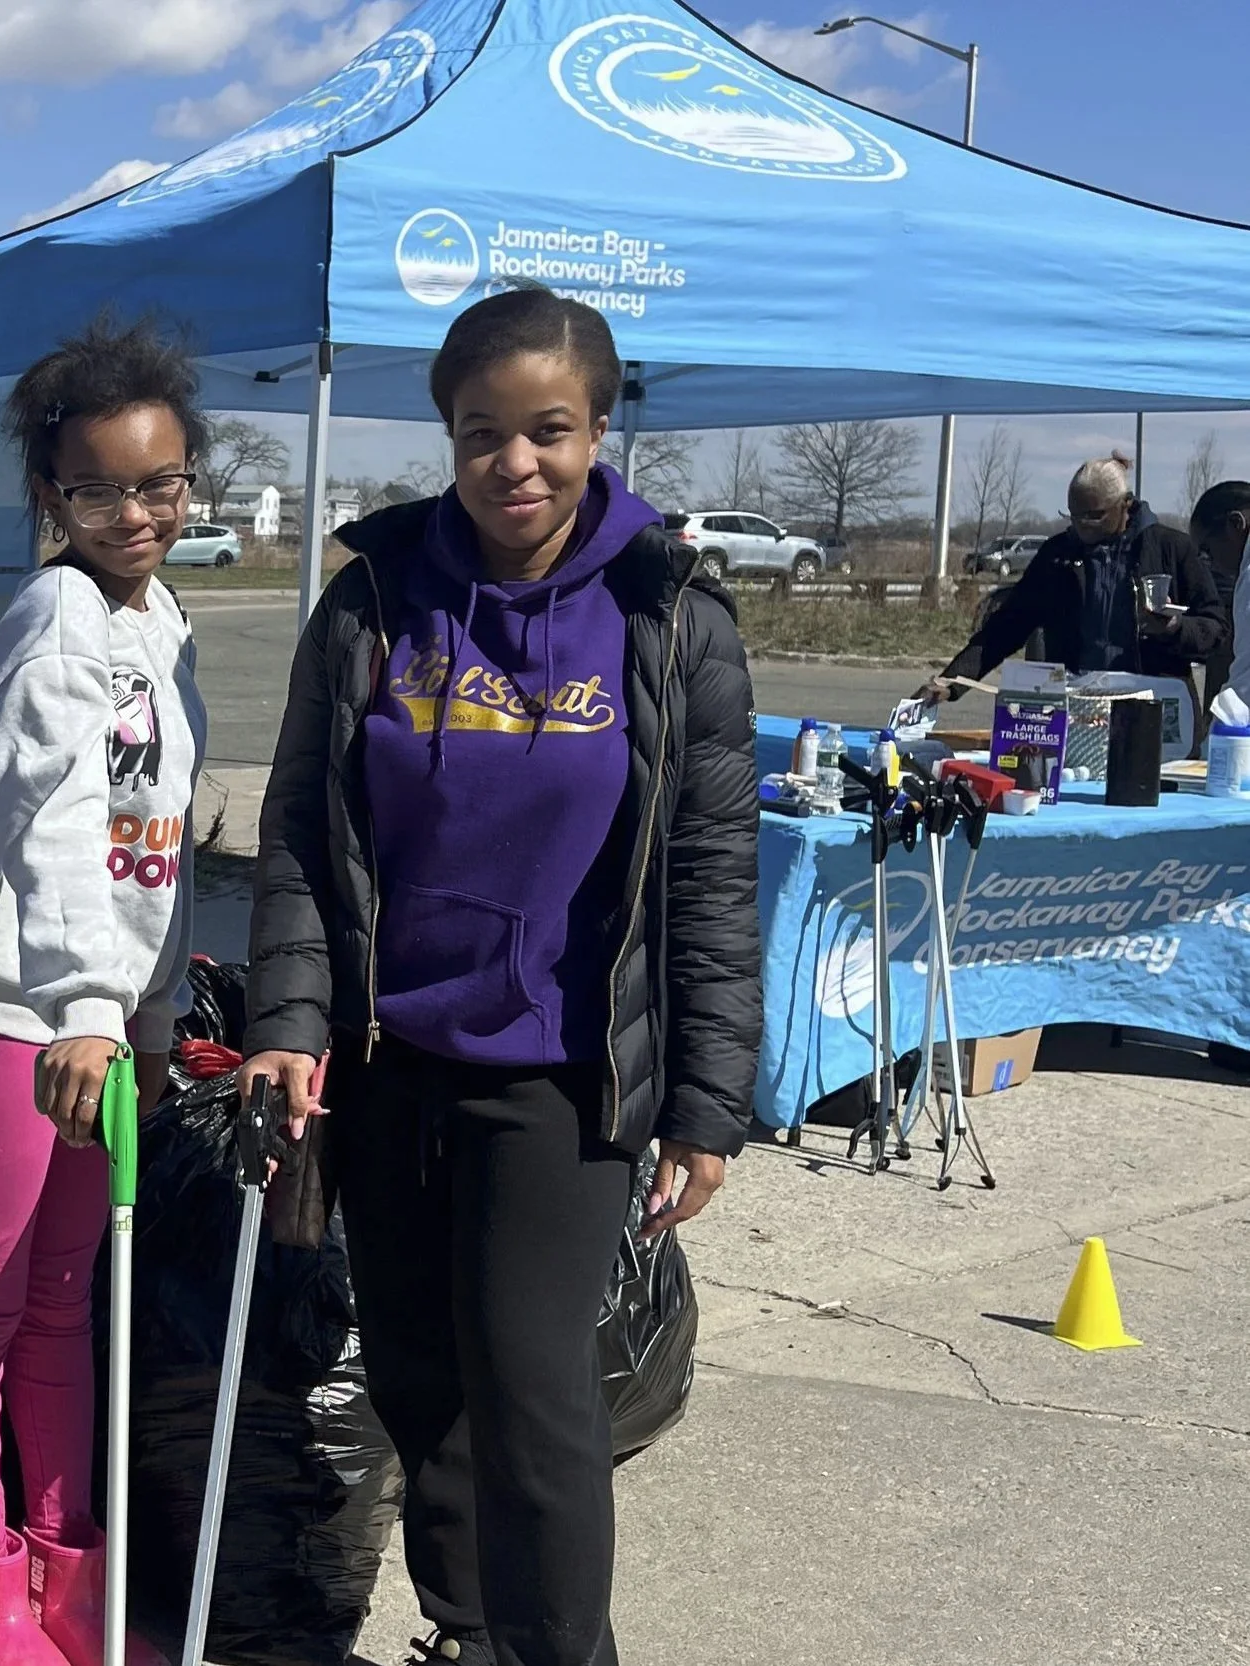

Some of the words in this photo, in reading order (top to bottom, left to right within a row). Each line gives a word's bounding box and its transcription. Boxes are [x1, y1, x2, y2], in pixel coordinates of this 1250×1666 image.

[488, 221, 597, 254] Jamaica
[603, 230, 649, 264] Bay
[488, 248, 616, 288] Rockaway
[619, 259, 686, 287] Parks
[1000, 730, 1032, 741] TRASH
[1033, 733, 1060, 743] BAGS
[1014, 723, 1046, 733] LARGE
[110, 813, 184, 852] DUN
[963, 866, 1143, 899] Jamaica
[1138, 859, 1224, 894] Bay
